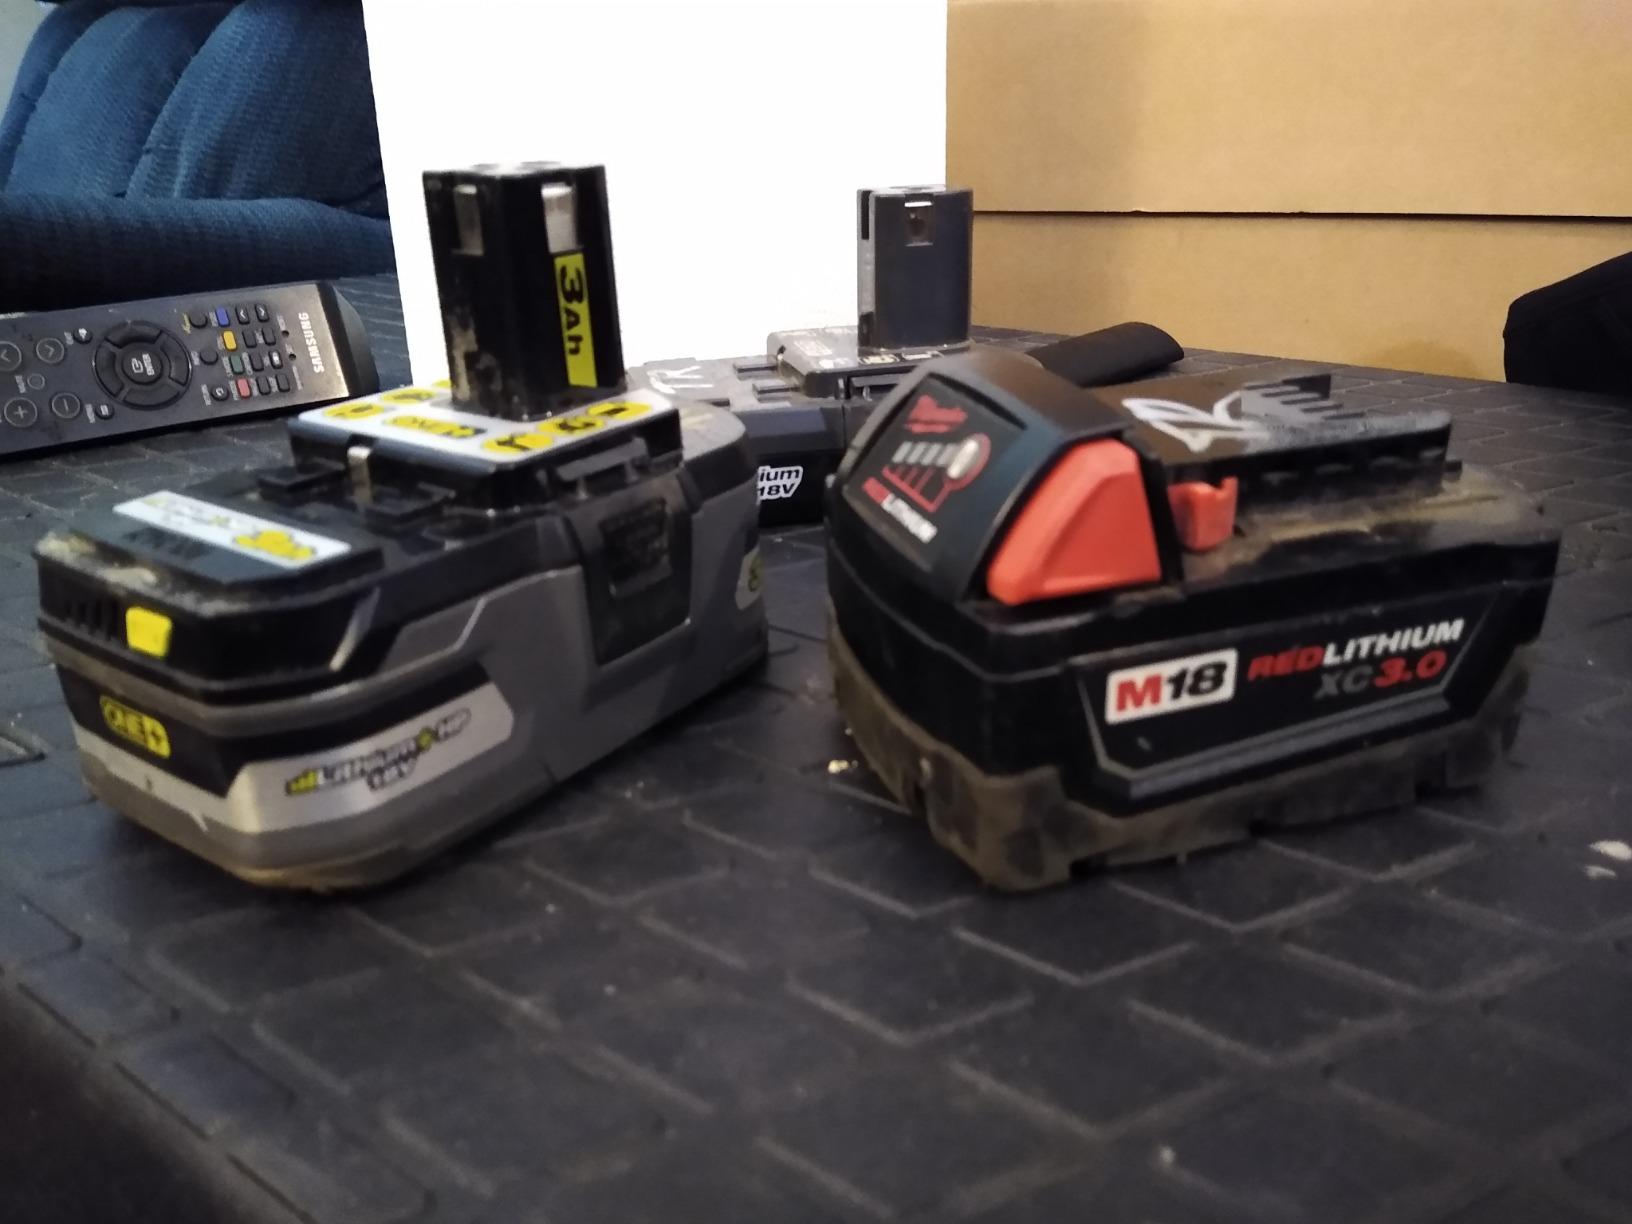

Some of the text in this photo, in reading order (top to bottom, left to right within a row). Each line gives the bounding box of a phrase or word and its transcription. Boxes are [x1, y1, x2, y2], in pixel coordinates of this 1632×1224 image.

[559, 264, 584, 356] 3Ah
[298, 312, 325, 373] SAMSUNG
[758, 483, 795, 497] 18V
[1247, 618, 1464, 682] REDLITHIUM
[1115, 661, 1227, 713] M18
